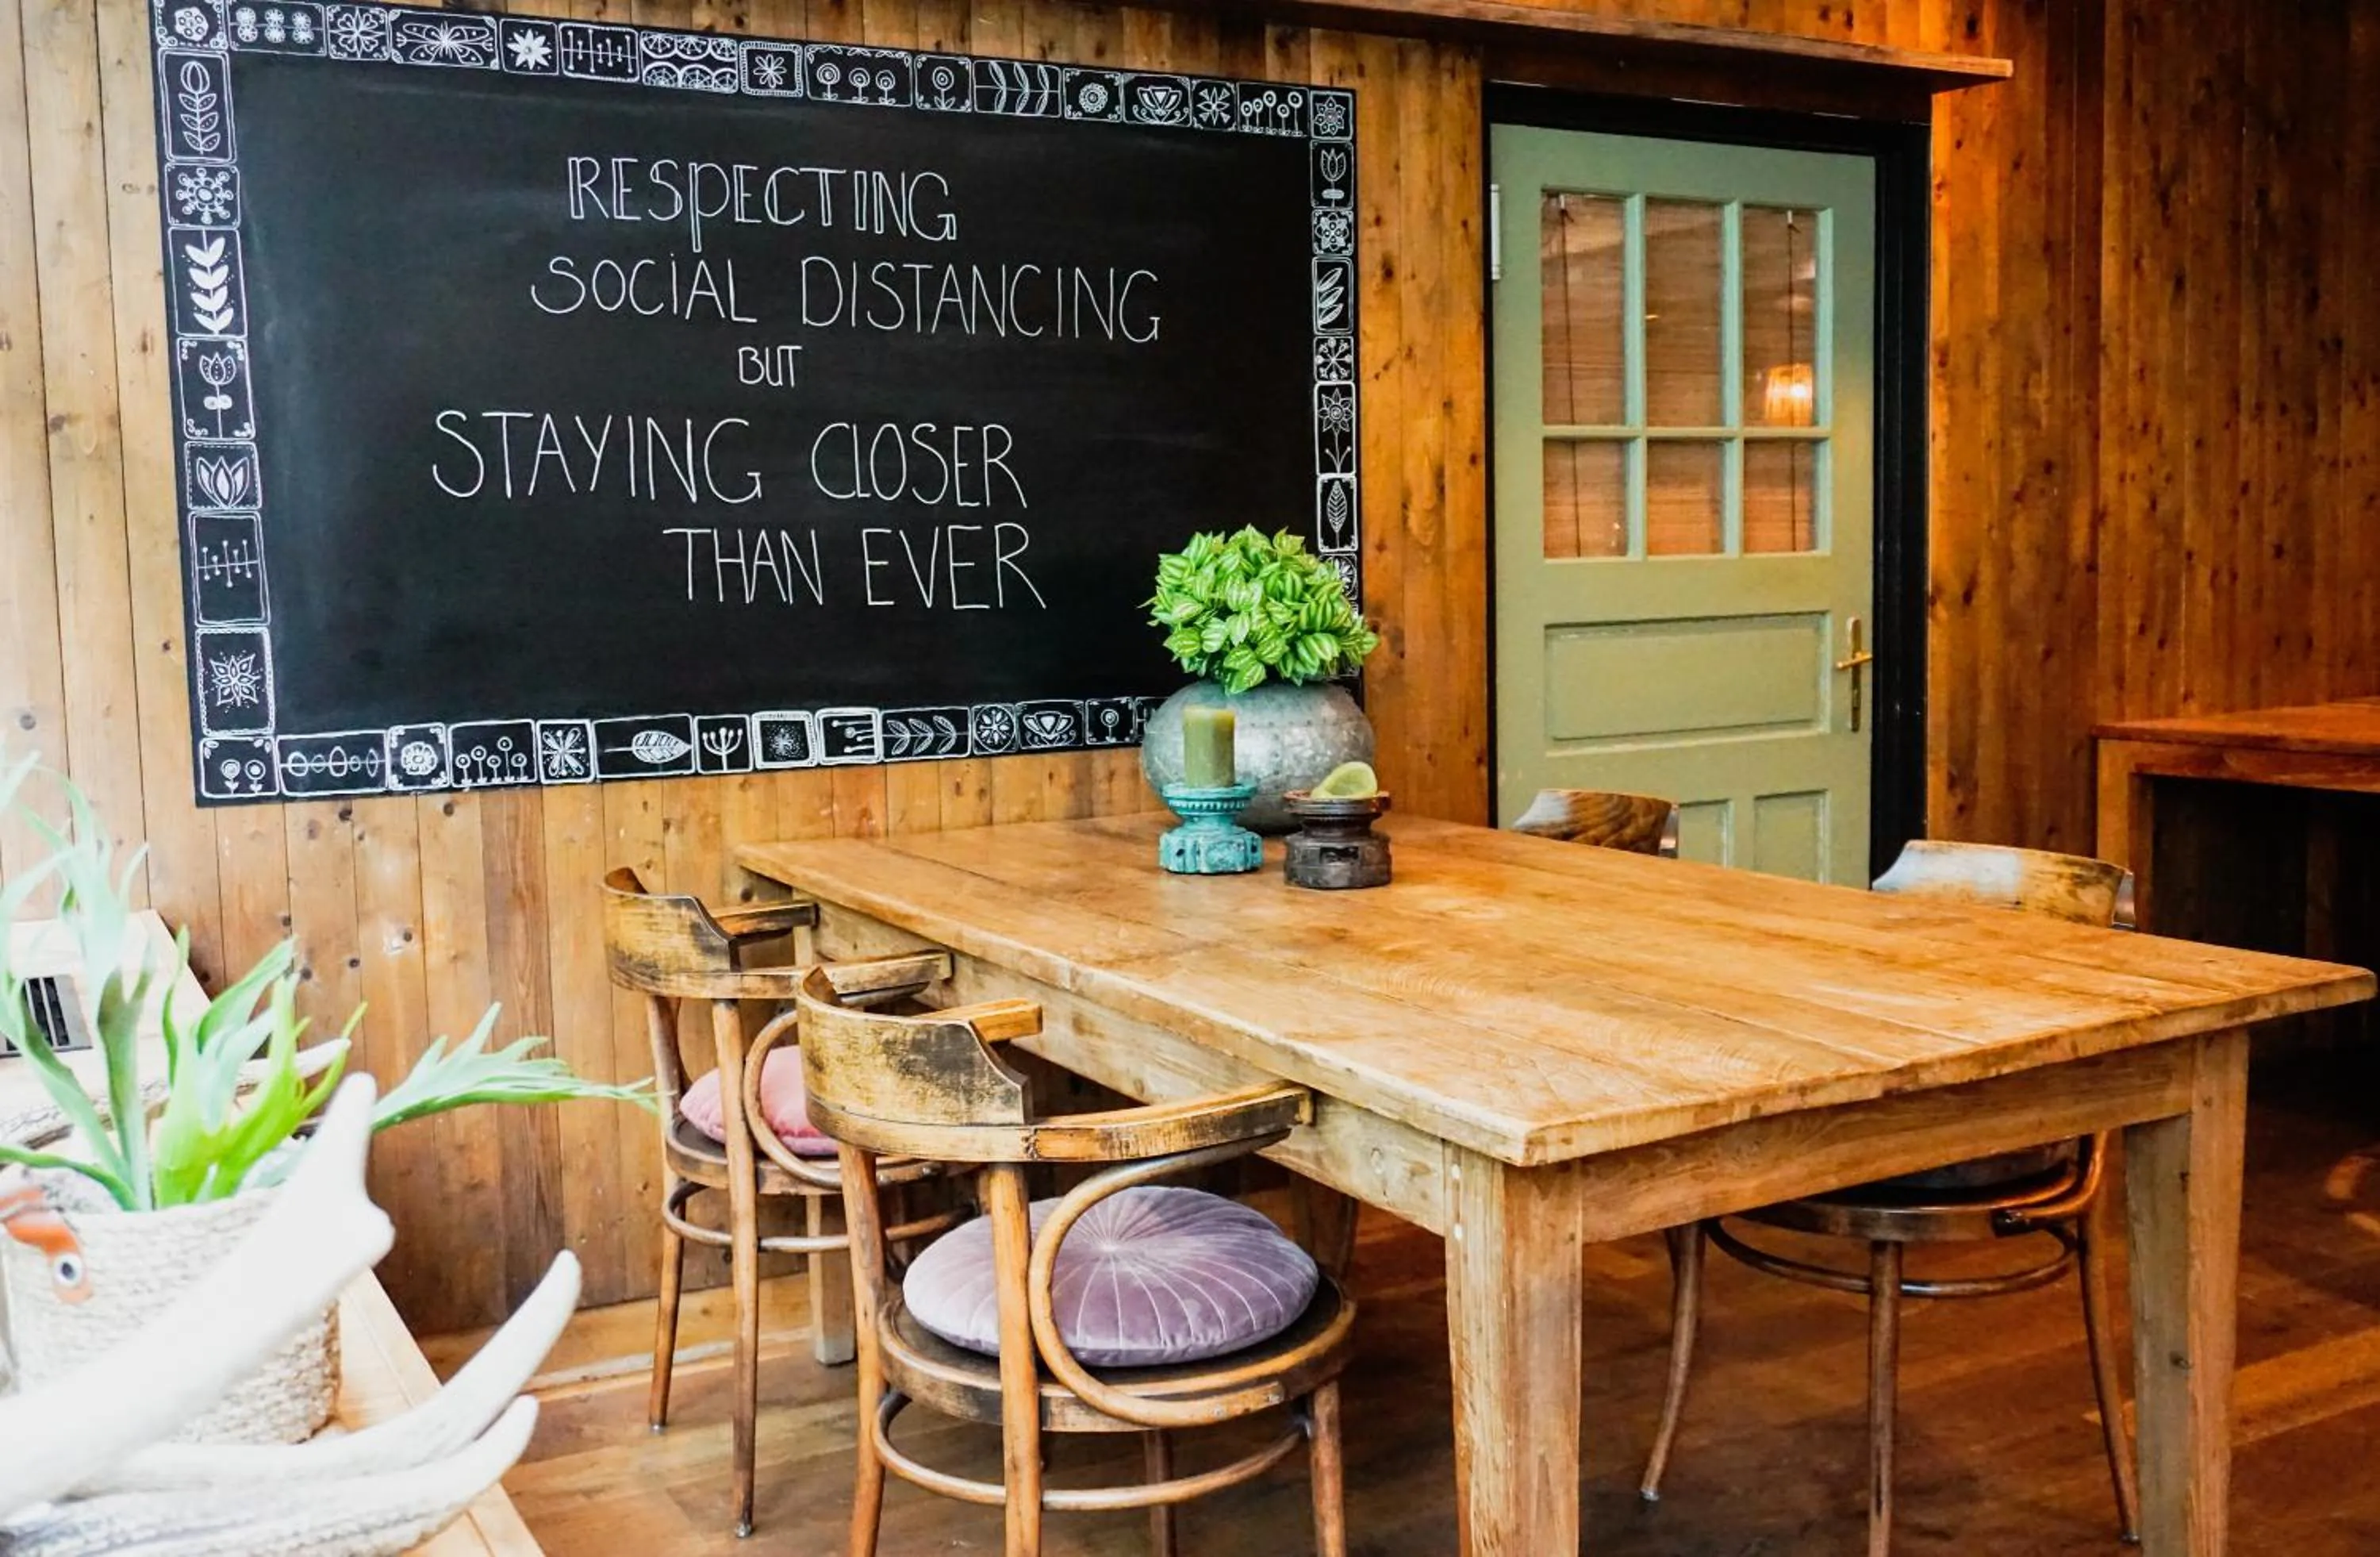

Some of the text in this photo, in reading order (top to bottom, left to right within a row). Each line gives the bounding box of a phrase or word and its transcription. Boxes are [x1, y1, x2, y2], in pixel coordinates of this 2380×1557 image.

[800, 256, 1161, 343] DISTANCING
[738, 344, 803, 388] BUT
[432, 409, 1027, 509] STAYING CLOSER
[662, 522, 1046, 610] THAN EVER
